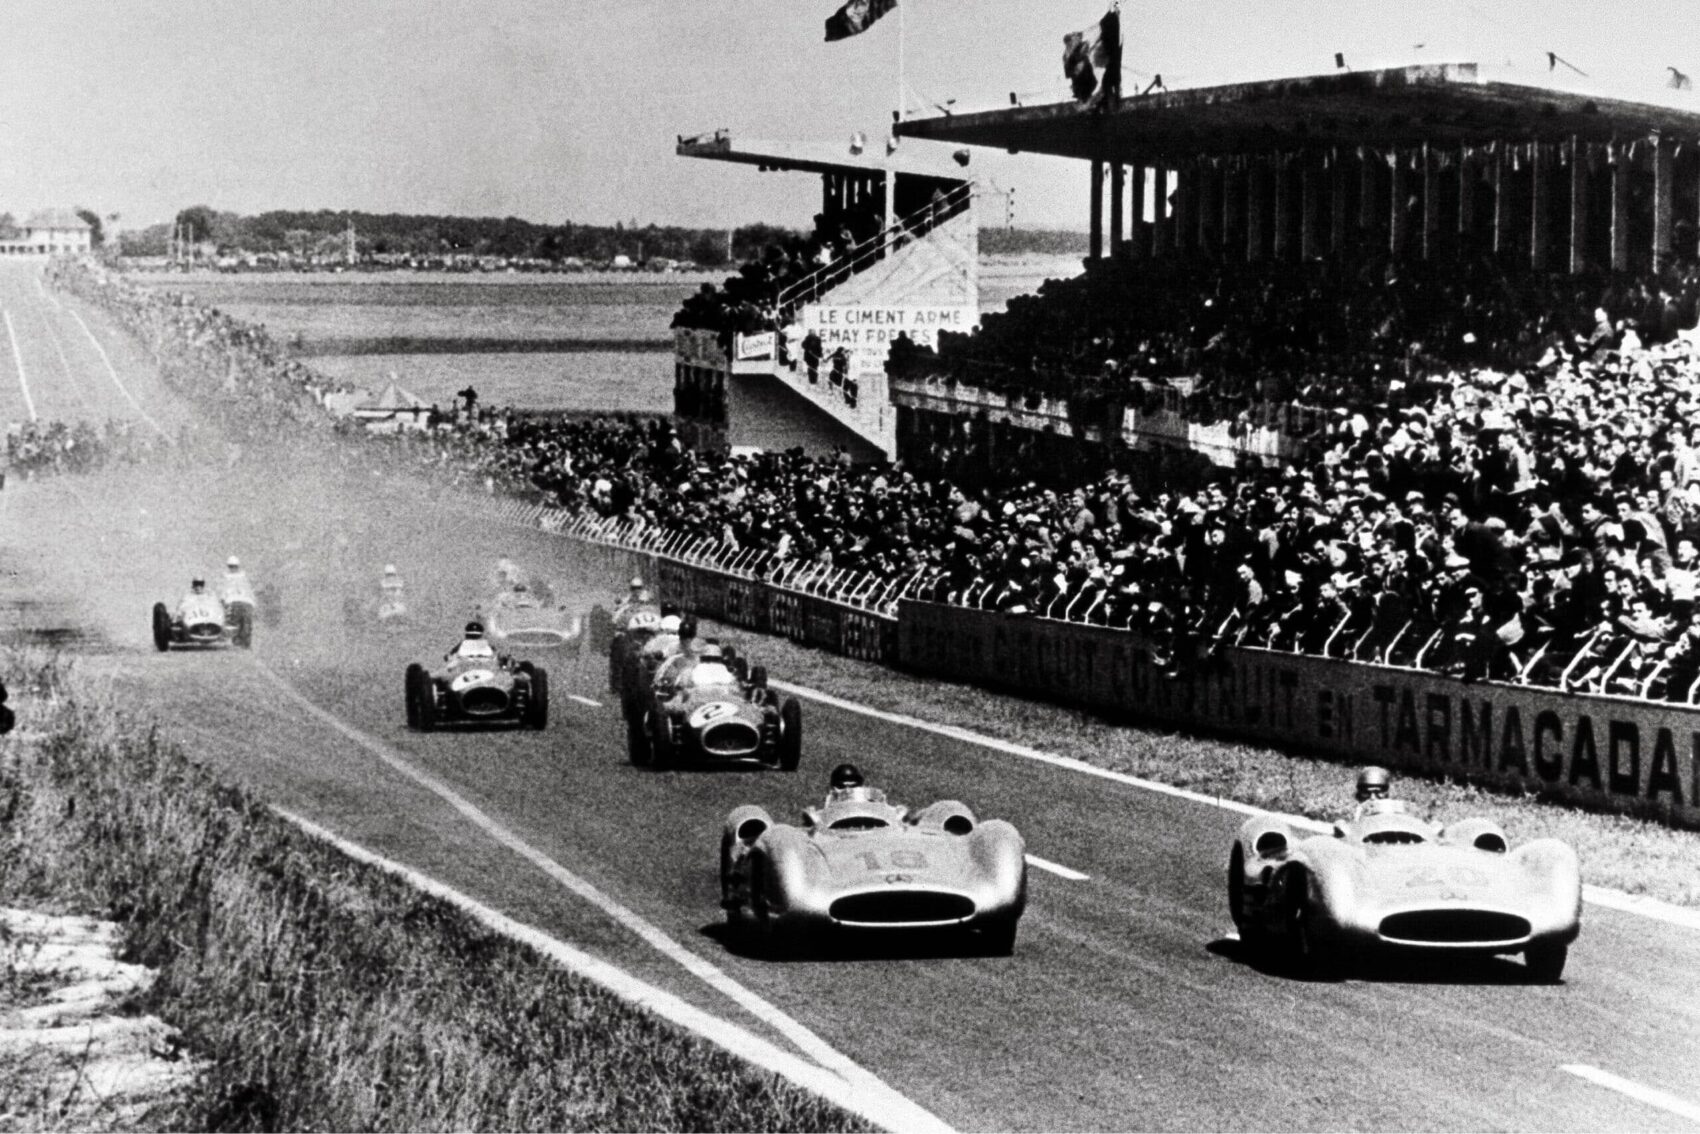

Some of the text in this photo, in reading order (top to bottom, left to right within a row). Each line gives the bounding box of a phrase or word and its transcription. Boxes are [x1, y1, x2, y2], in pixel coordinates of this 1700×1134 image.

[819, 309, 961, 325] LE CIMENT ARME
[866, 328, 930, 343] FREES
[1319, 690, 1353, 746] EN
[1373, 685, 1700, 807] TARMACADA
